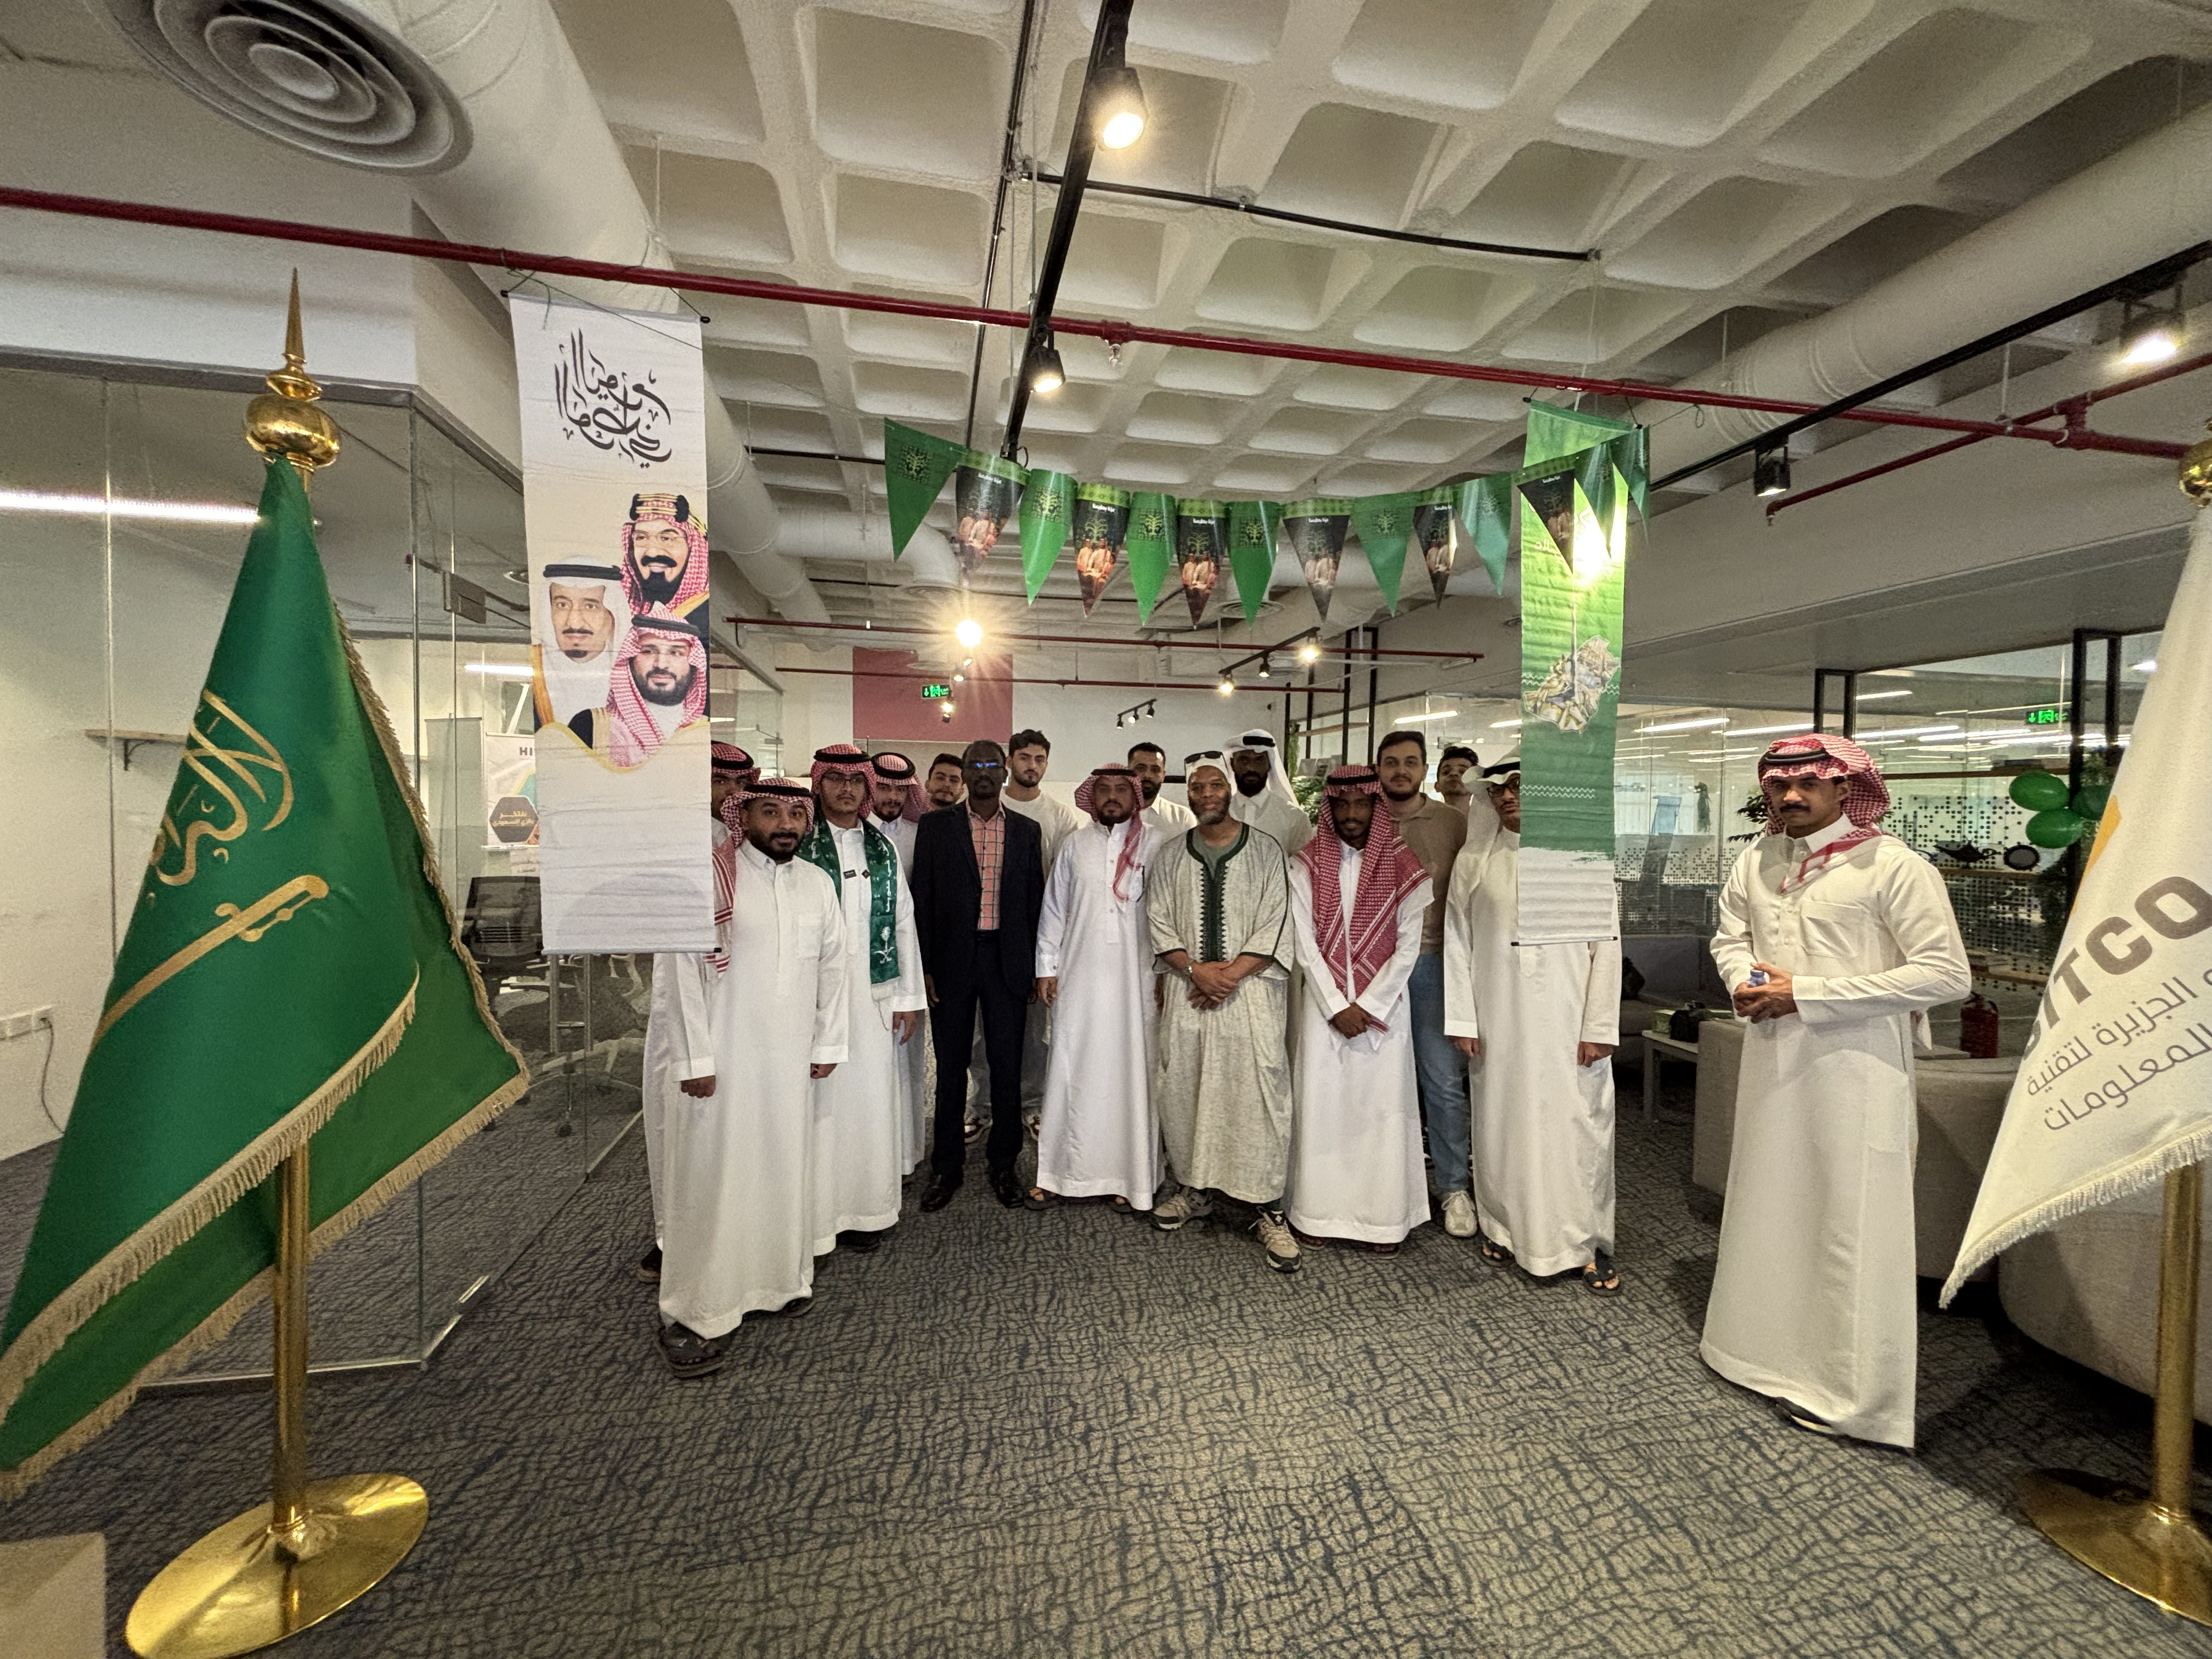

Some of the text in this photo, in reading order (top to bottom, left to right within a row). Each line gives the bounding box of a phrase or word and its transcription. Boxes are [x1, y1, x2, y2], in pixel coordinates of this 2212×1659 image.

[2028, 976, 2199, 1096] الجزيرة لتقنية
[2044, 1023, 2212, 1131] المعلومات
